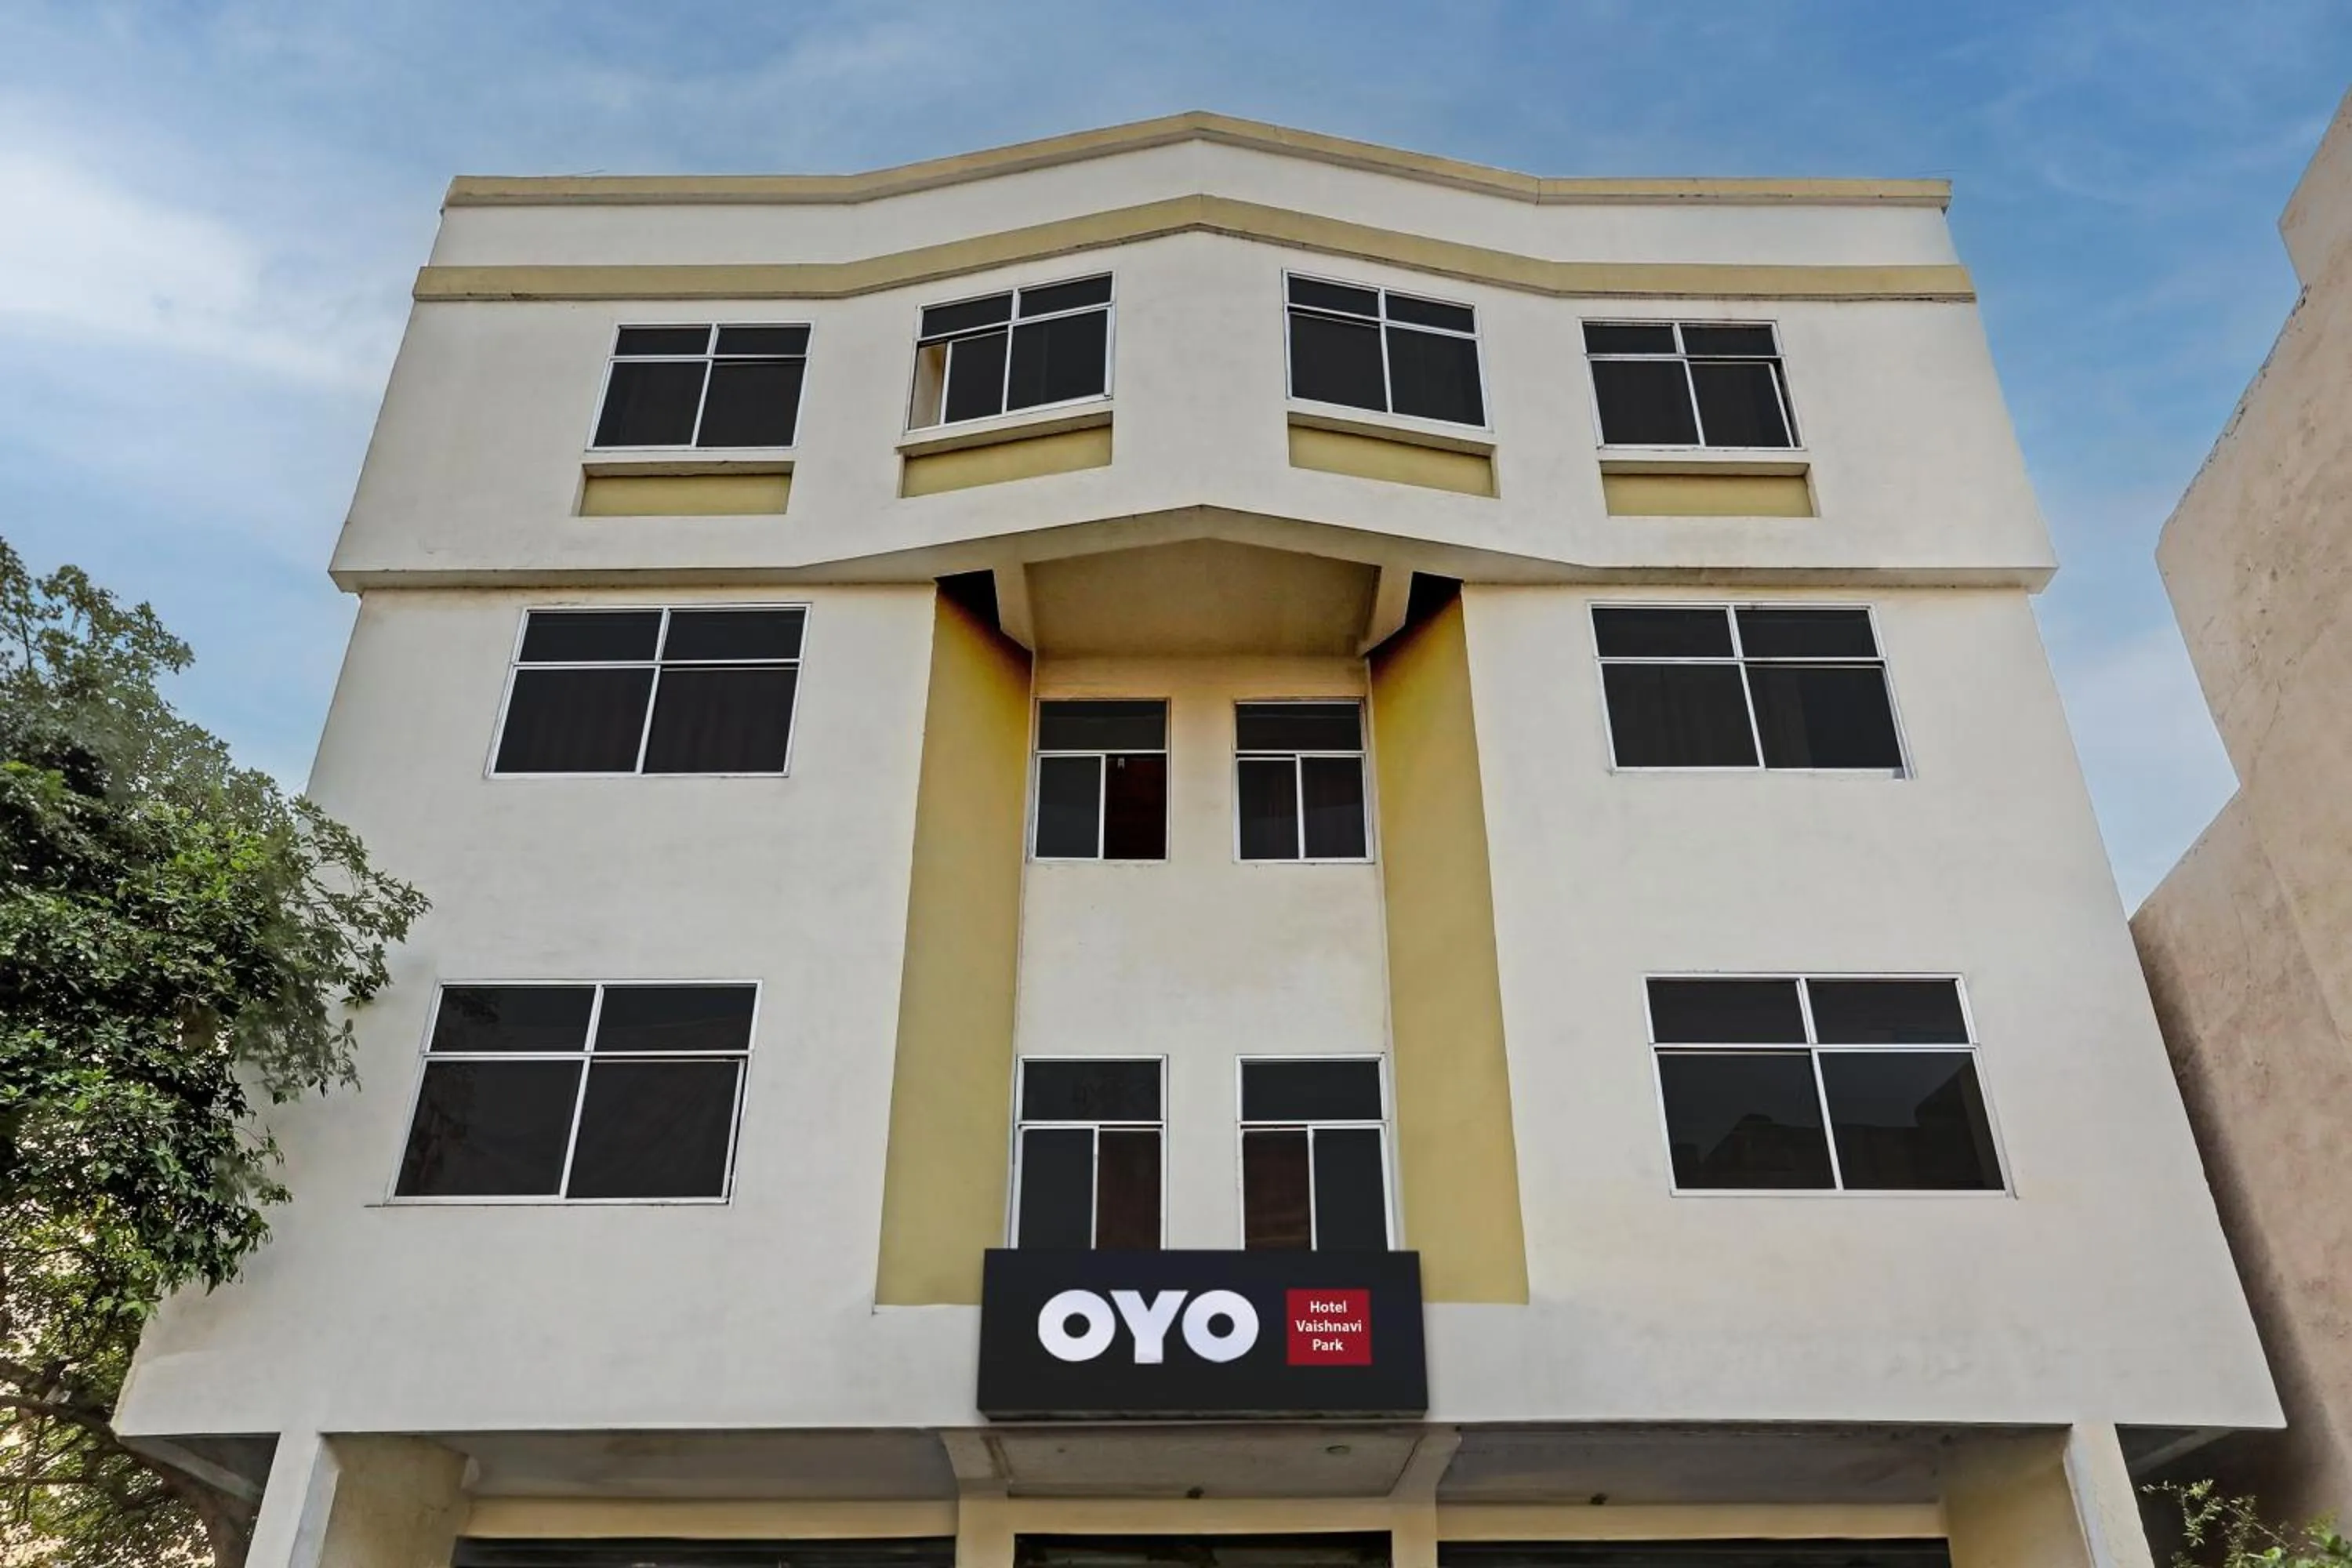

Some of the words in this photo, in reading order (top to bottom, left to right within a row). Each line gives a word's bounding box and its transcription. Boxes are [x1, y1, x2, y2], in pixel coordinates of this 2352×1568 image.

[1309, 1300, 1347, 1313] Hotel
[1038, 1290, 1259, 1363] OYO
[1295, 1319, 1363, 1333] Vaishnavi
[1312, 1338, 1344, 1352] Park
